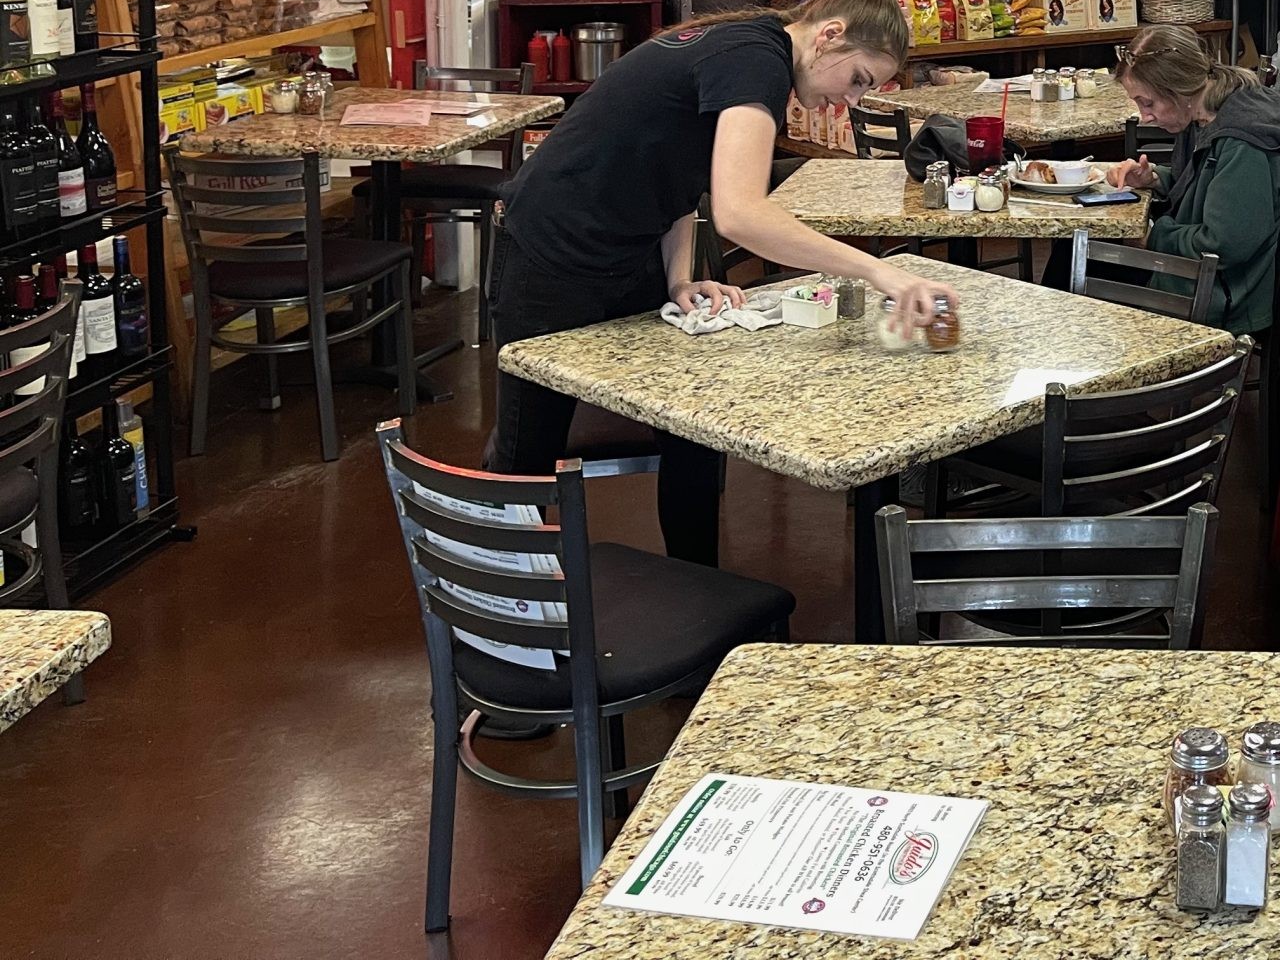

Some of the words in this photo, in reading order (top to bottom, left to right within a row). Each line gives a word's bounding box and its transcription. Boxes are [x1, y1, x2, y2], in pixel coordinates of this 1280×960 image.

[736, 820, 757, 835] Only
[859, 809, 887, 837] Broasted
[841, 838, 869, 867] Chicken
[855, 824, 894, 883] 480-951-0636
[824, 869, 851, 898] Dinners
